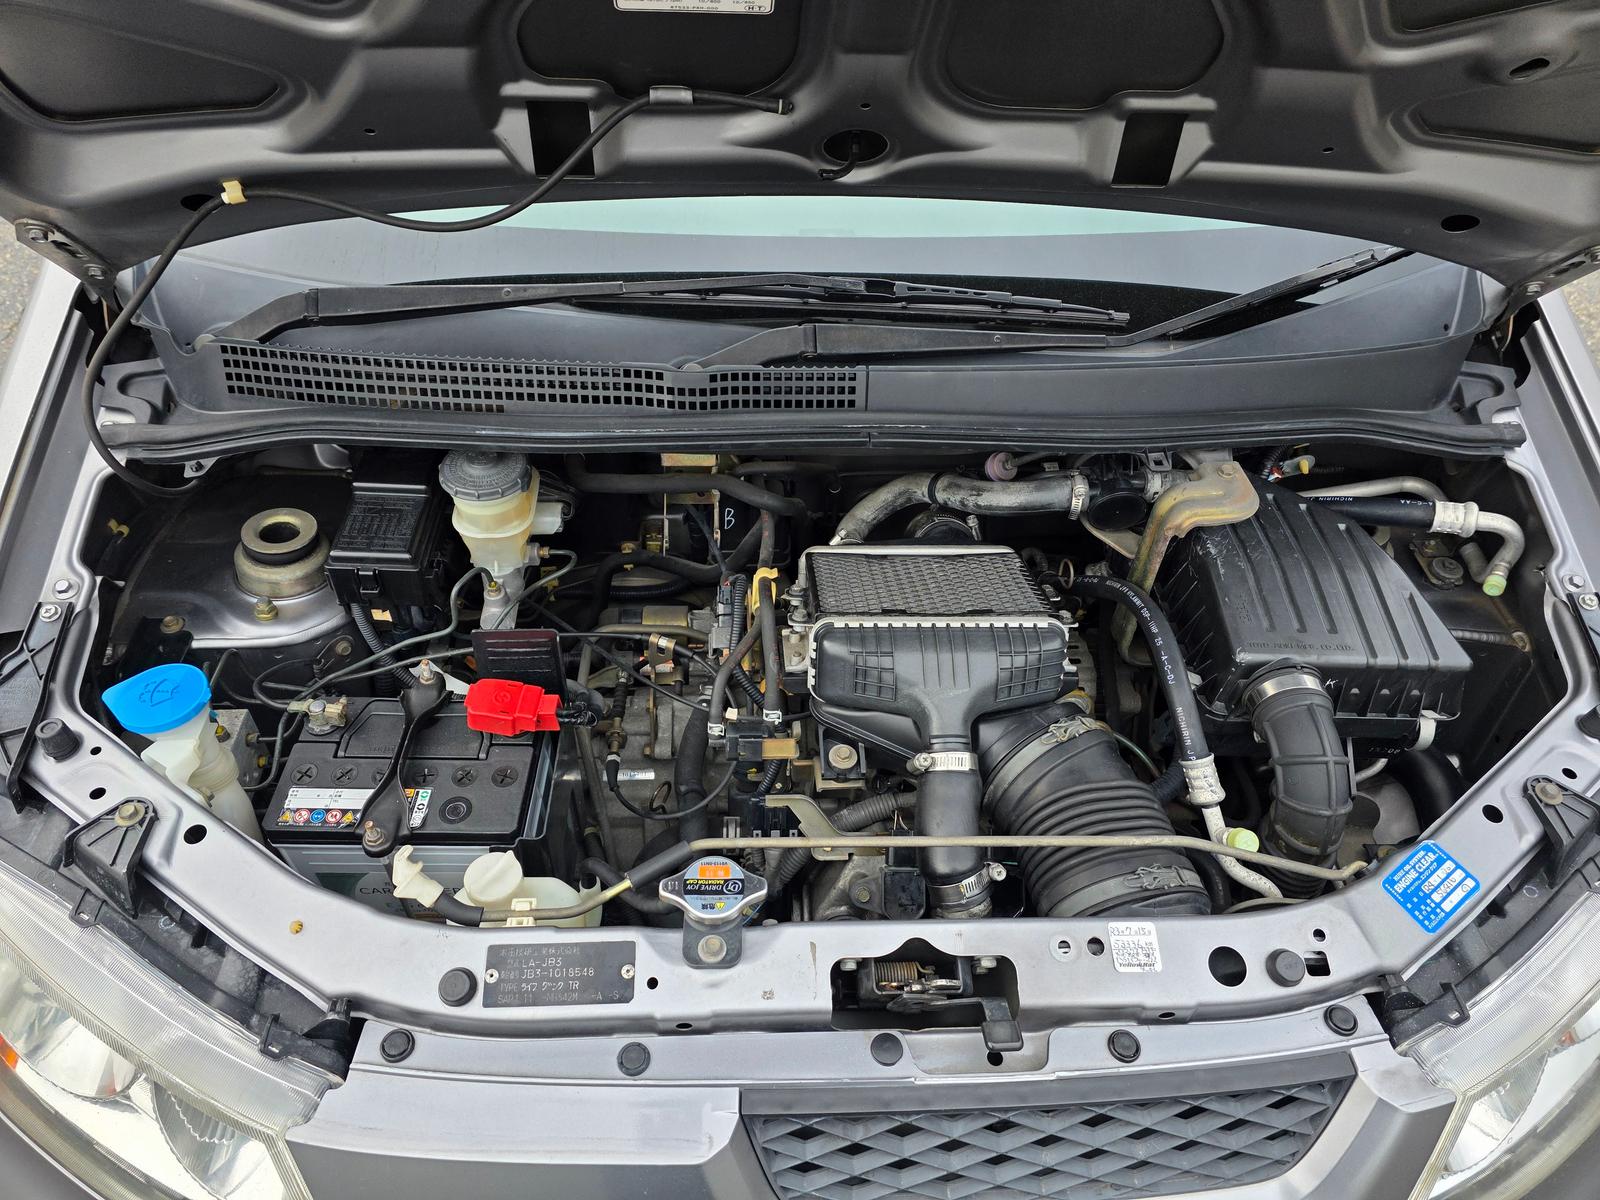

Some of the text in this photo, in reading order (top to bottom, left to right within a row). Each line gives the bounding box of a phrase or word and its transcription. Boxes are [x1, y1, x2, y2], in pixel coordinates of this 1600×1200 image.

[723, 507, 735, 530] B
[1176, 706, 1192, 746] NICHIRIN
[686, 883, 700, 891] JOY
[1393, 869, 1419, 893] ENGINE
[521, 957, 563, 968] LA-JB3
[568, 980, 580, 990] TR
